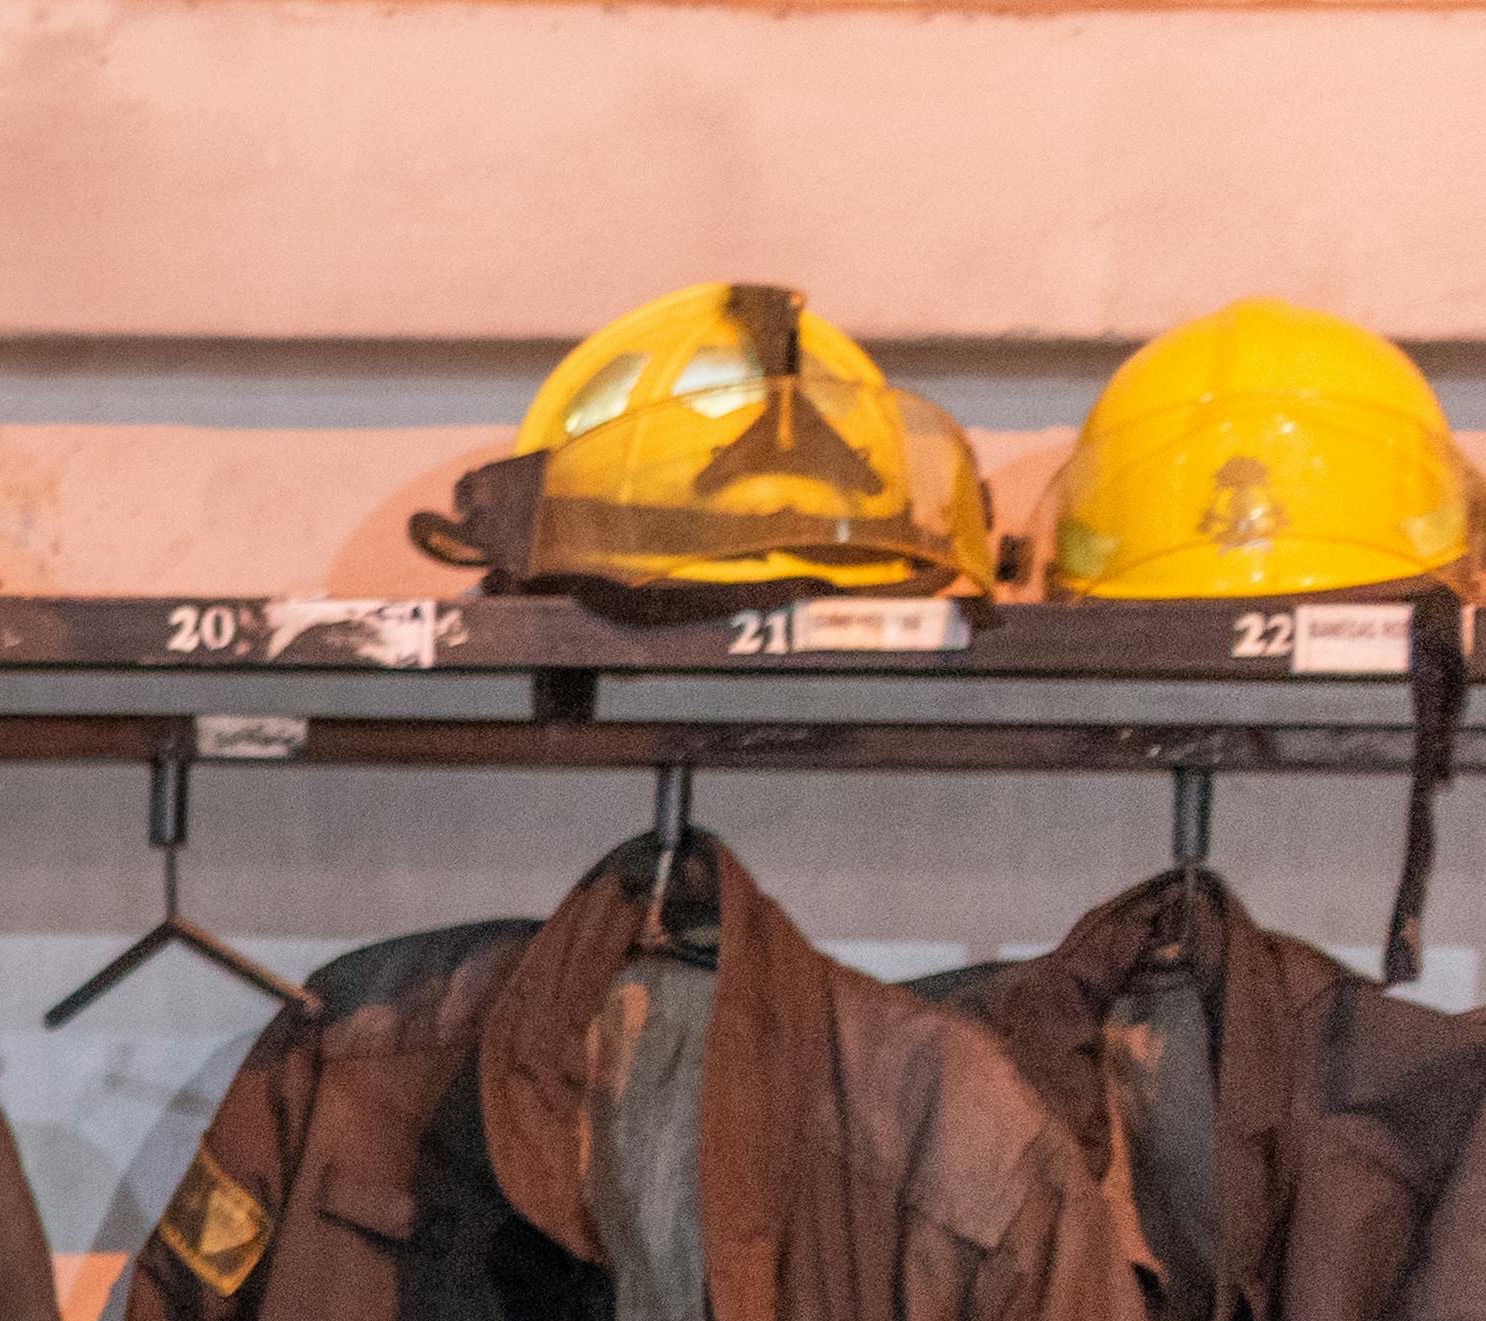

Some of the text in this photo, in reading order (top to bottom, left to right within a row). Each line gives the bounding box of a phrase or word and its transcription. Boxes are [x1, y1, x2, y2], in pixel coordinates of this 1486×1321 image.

[166, 606, 237, 652] 20
[729, 609, 790, 654] 21
[1232, 612, 1291, 658] 22
